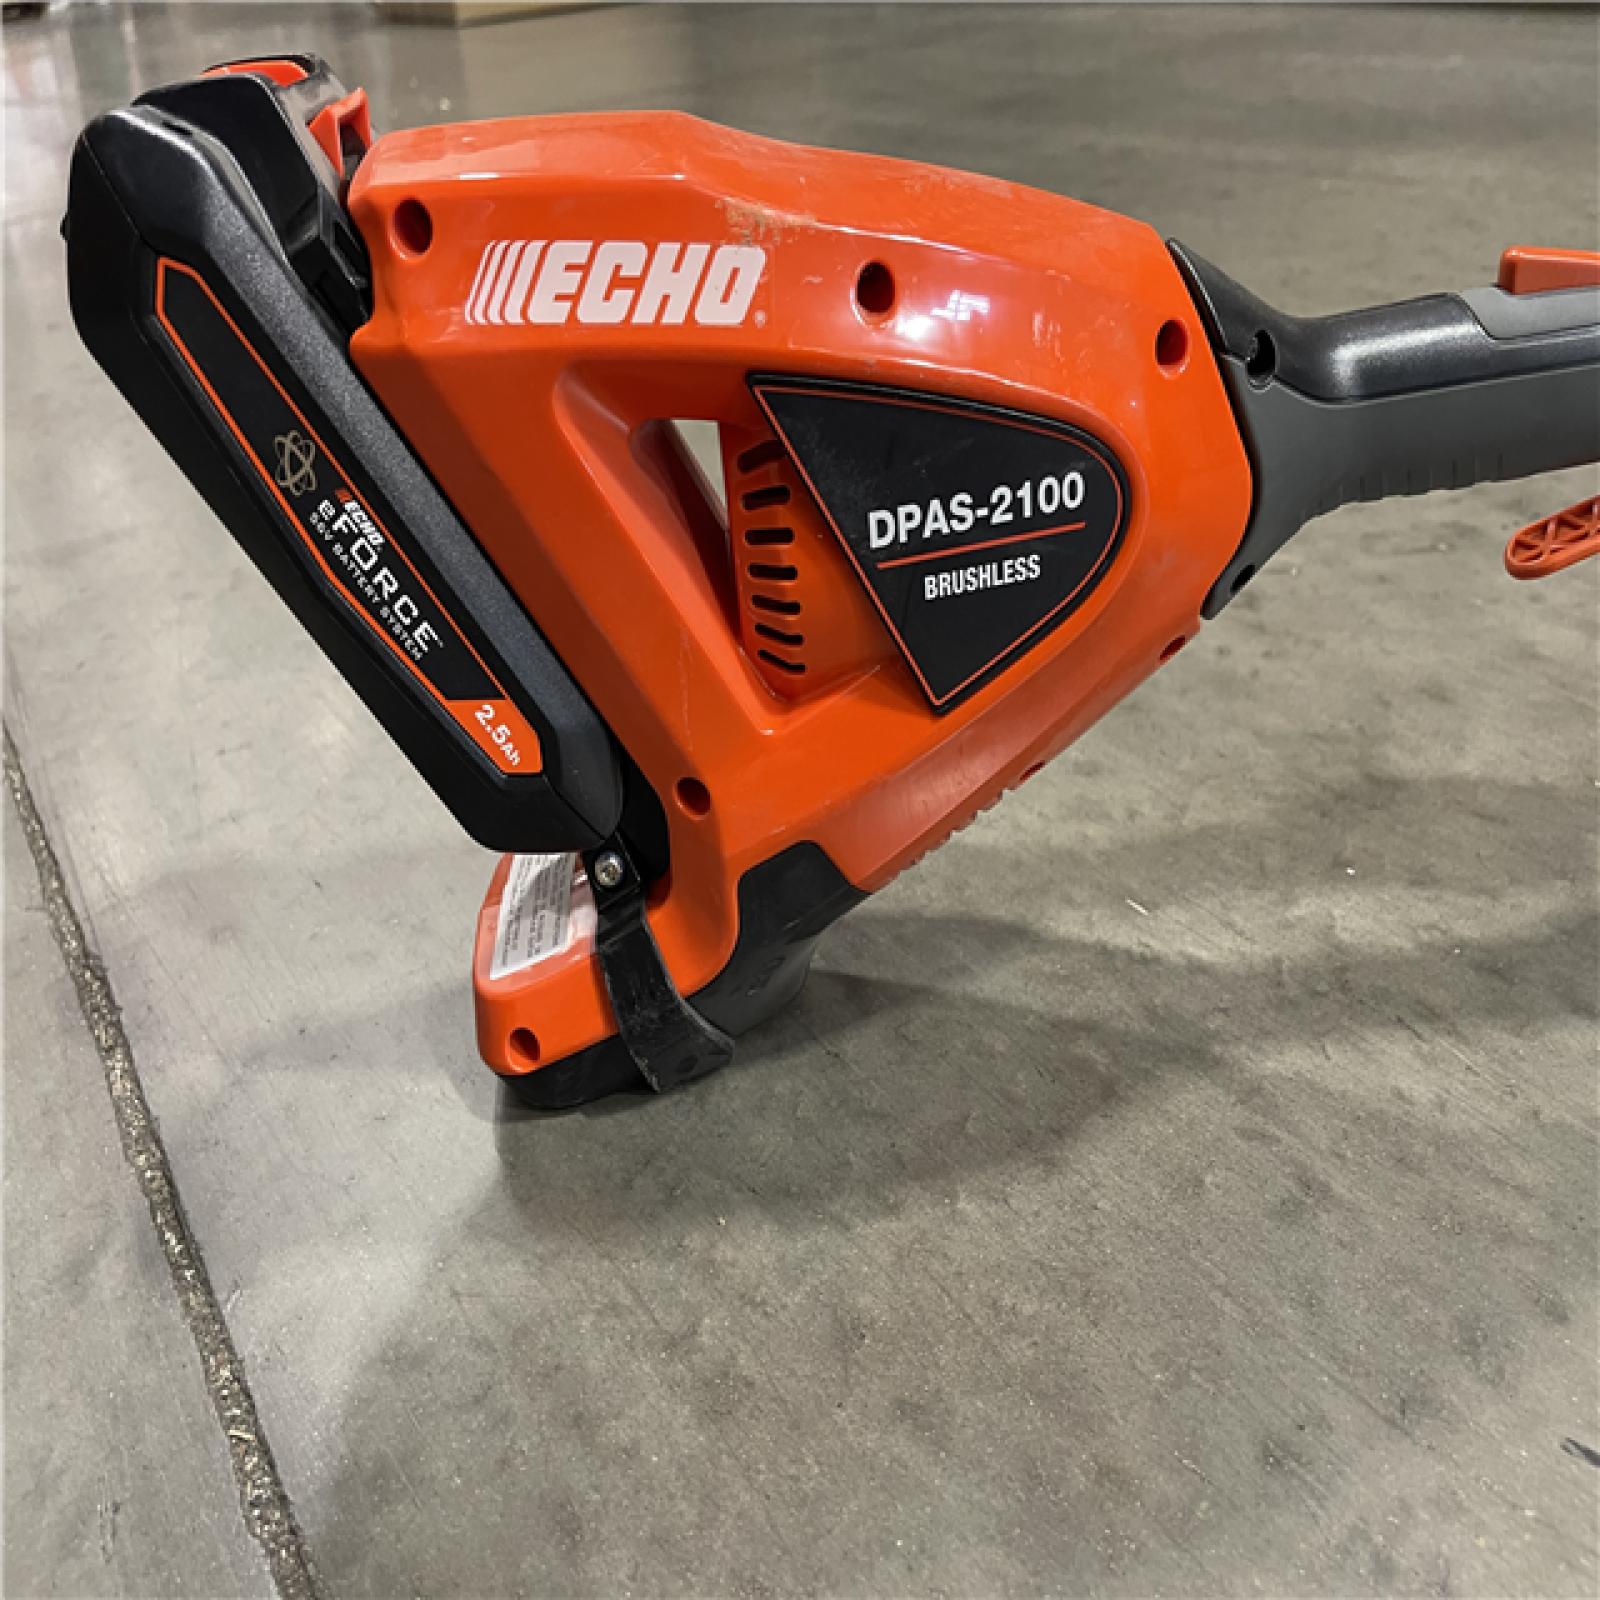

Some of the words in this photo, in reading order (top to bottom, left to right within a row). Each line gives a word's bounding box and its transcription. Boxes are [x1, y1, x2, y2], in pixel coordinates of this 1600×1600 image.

[526, 240, 766, 325] ECHO
[344, 500, 385, 546] ECHO
[868, 471, 1085, 549] DPAS-2100
[317, 499, 438, 653] eFORCE
[332, 542, 380, 604] BATTERY
[380, 605, 423, 660] SYSTEM
[924, 554, 1041, 601] BRUSHLESS
